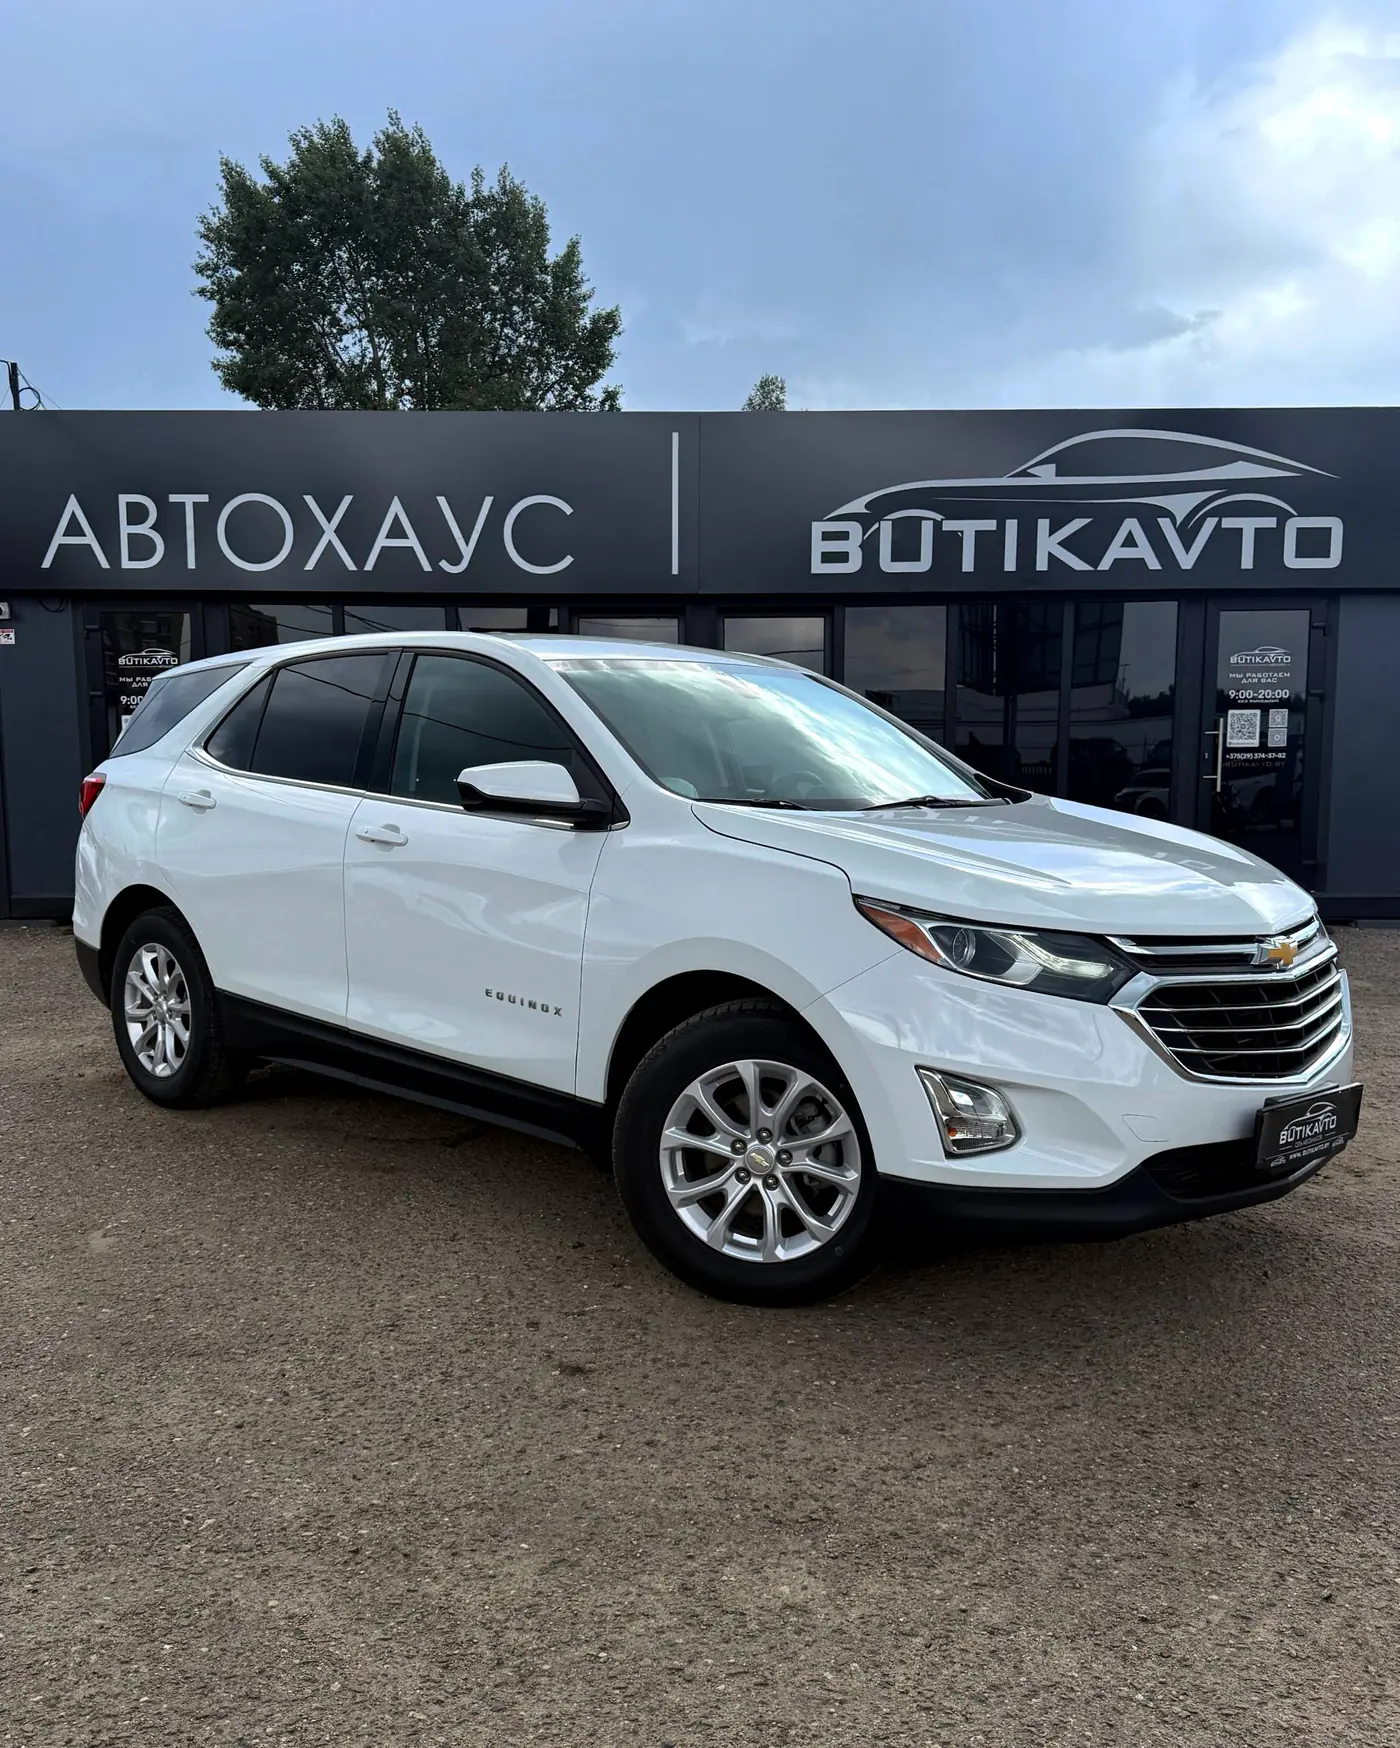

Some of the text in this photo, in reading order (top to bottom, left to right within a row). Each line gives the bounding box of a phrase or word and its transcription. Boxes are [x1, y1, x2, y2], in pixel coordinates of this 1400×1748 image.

[41, 493, 575, 575] АВТОХАУС
[810, 516, 1344, 575] BUTIKAVTO
[118, 657, 178, 665] BUTIKAVTO
[1230, 655, 1291, 664] BUTIKAVTO
[1229, 689, 1290, 699] 9:00-20:00
[485, 988, 563, 1017] EQUINOX
[1279, 1115, 1337, 1145] BUTIKAVTO
